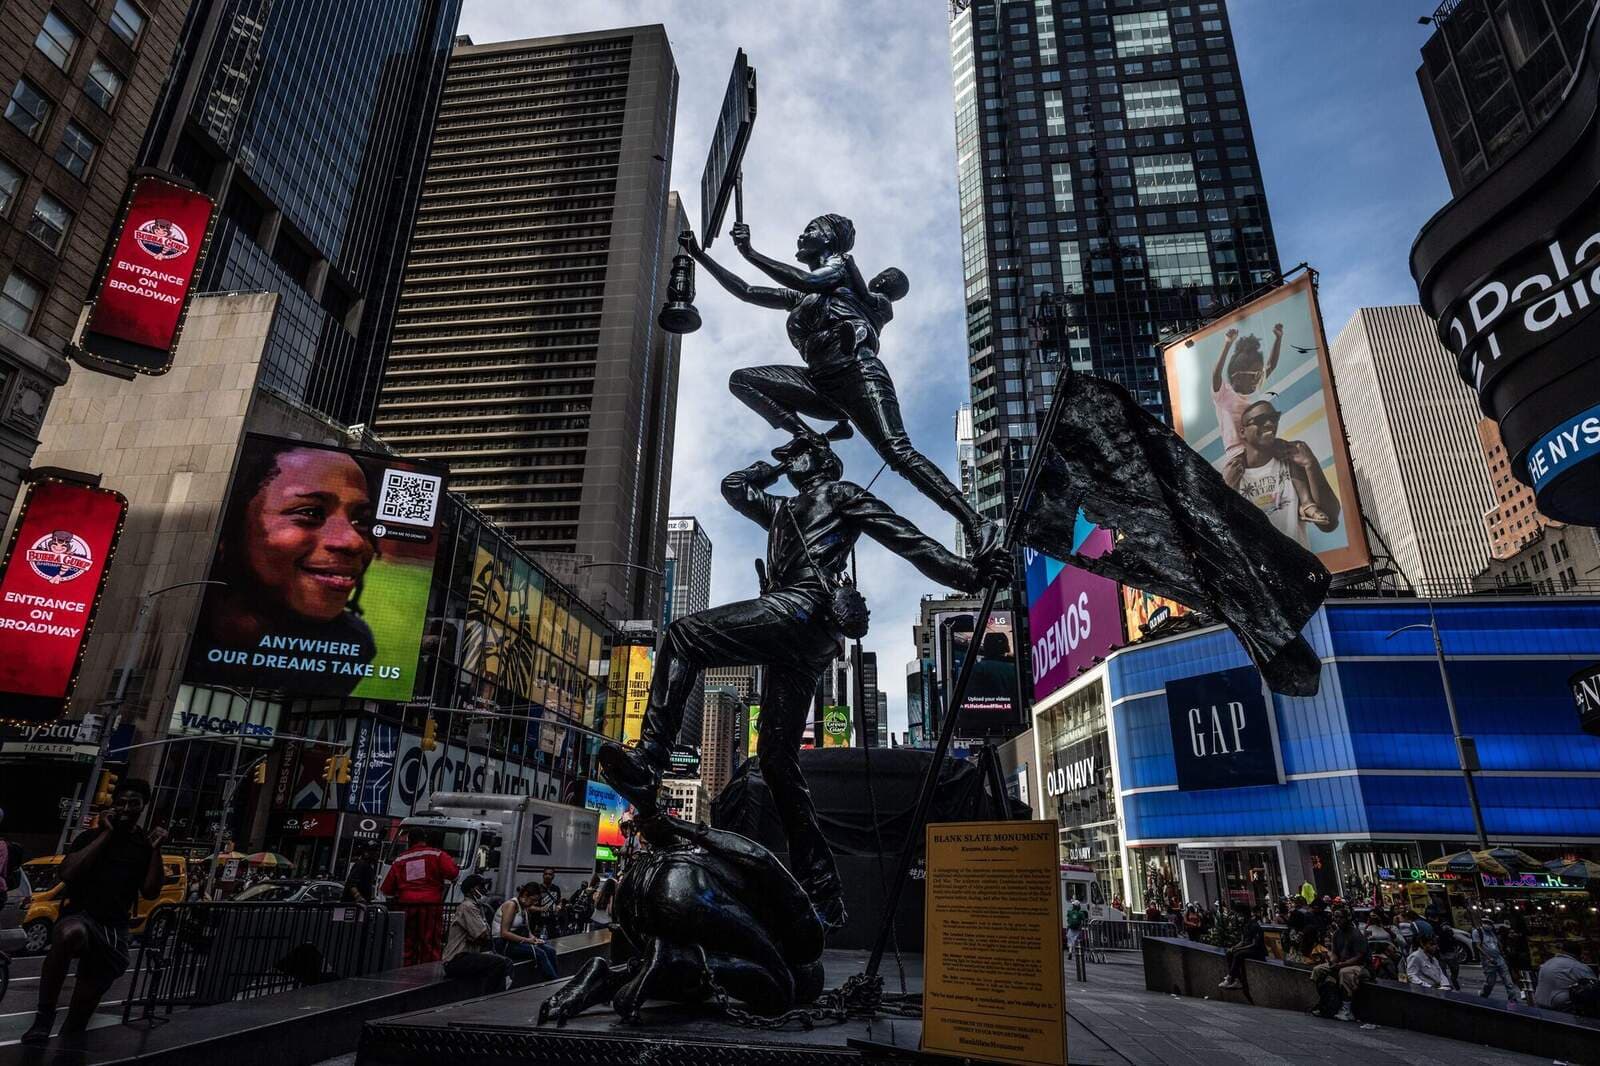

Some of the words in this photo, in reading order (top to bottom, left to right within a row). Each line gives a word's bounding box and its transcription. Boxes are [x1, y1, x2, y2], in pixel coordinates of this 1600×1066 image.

[118, 261, 185, 286] ENTRANCE
[139, 277, 158, 289] ON
[109, 279, 180, 305] BROADWAY
[28, 550, 61, 562] BUBBA
[63, 555, 91, 570] GUMP
[4, 591, 86, 613] ENTRANCE
[30, 609, 54, 621] ON
[0, 617, 80, 638] BROADWAY
[1032, 592, 1091, 685] ODEMOS
[259, 634, 361, 657] ANYWHERE
[207, 648, 248, 665] OUR
[252, 652, 327, 673] DREAMS
[331, 660, 374, 677] TAKE
[378, 665, 401, 680] US
[1188, 702, 1246, 757] GAP
[24, 743, 73, 752] THEATER
[1047, 768, 1065, 797] OLD
[1066, 756, 1095, 792] NAVY
[934, 834, 962, 843] BLANK
[964, 833, 992, 842] SLATE
[994, 832, 1050, 842] MONUMENT
